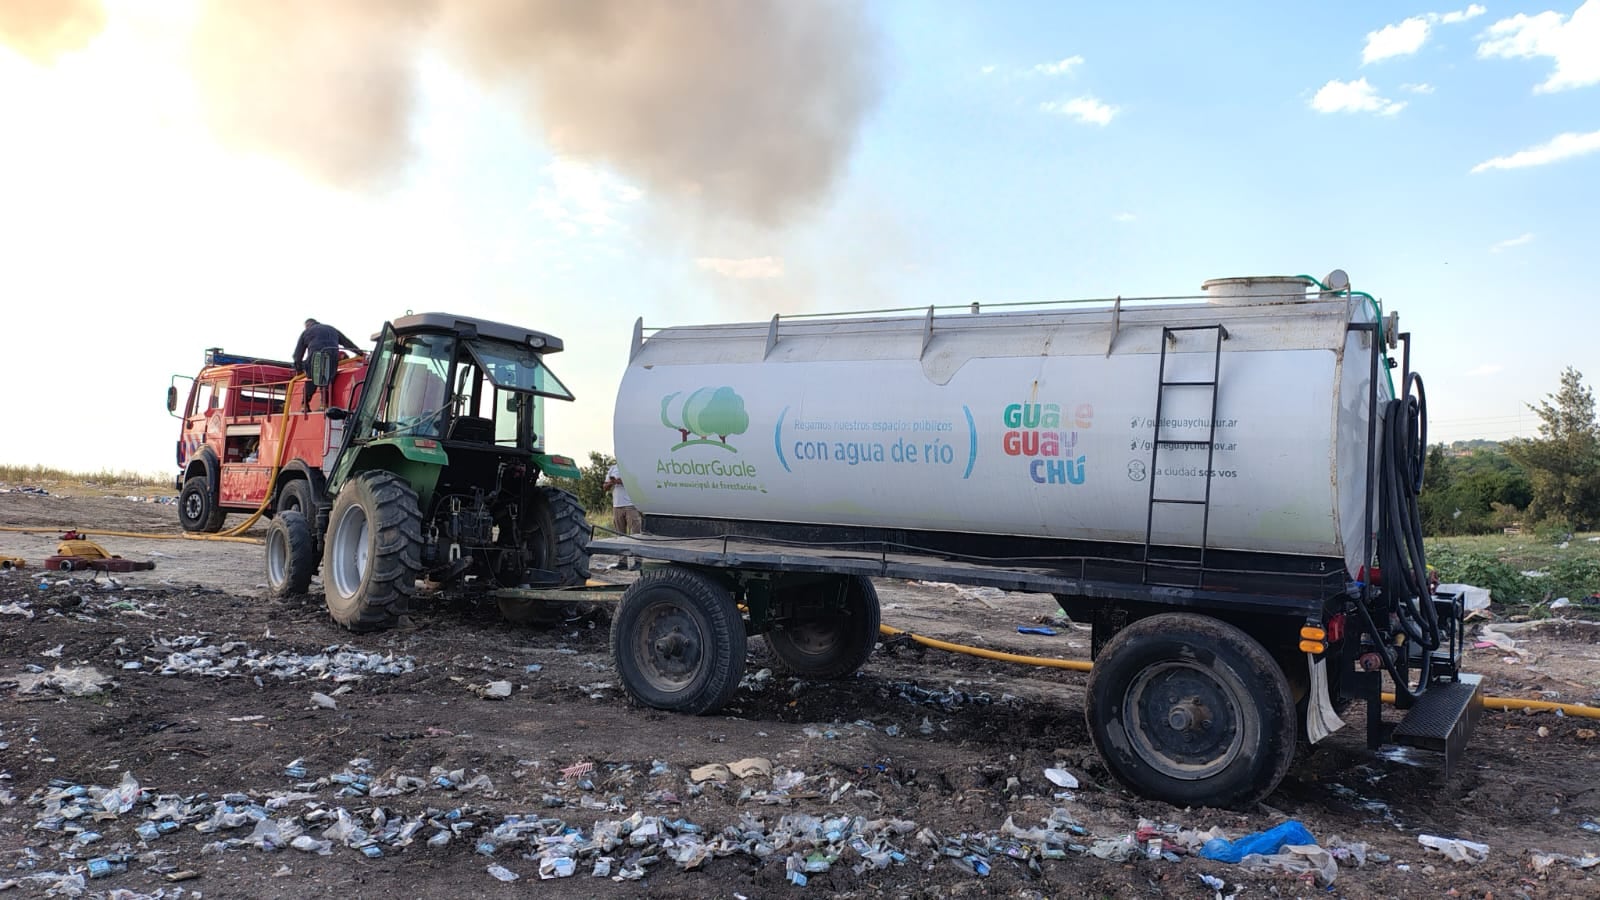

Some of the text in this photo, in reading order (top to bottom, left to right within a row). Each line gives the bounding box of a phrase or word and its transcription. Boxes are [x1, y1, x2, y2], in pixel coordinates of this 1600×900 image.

[794, 437, 954, 465] con agua de río
[656, 458, 756, 478] ArbolarGuale
[1029, 455, 1086, 485] CHÚ
[1164, 467, 1196, 477] ciudad
[1218, 470, 1238, 478] vos
